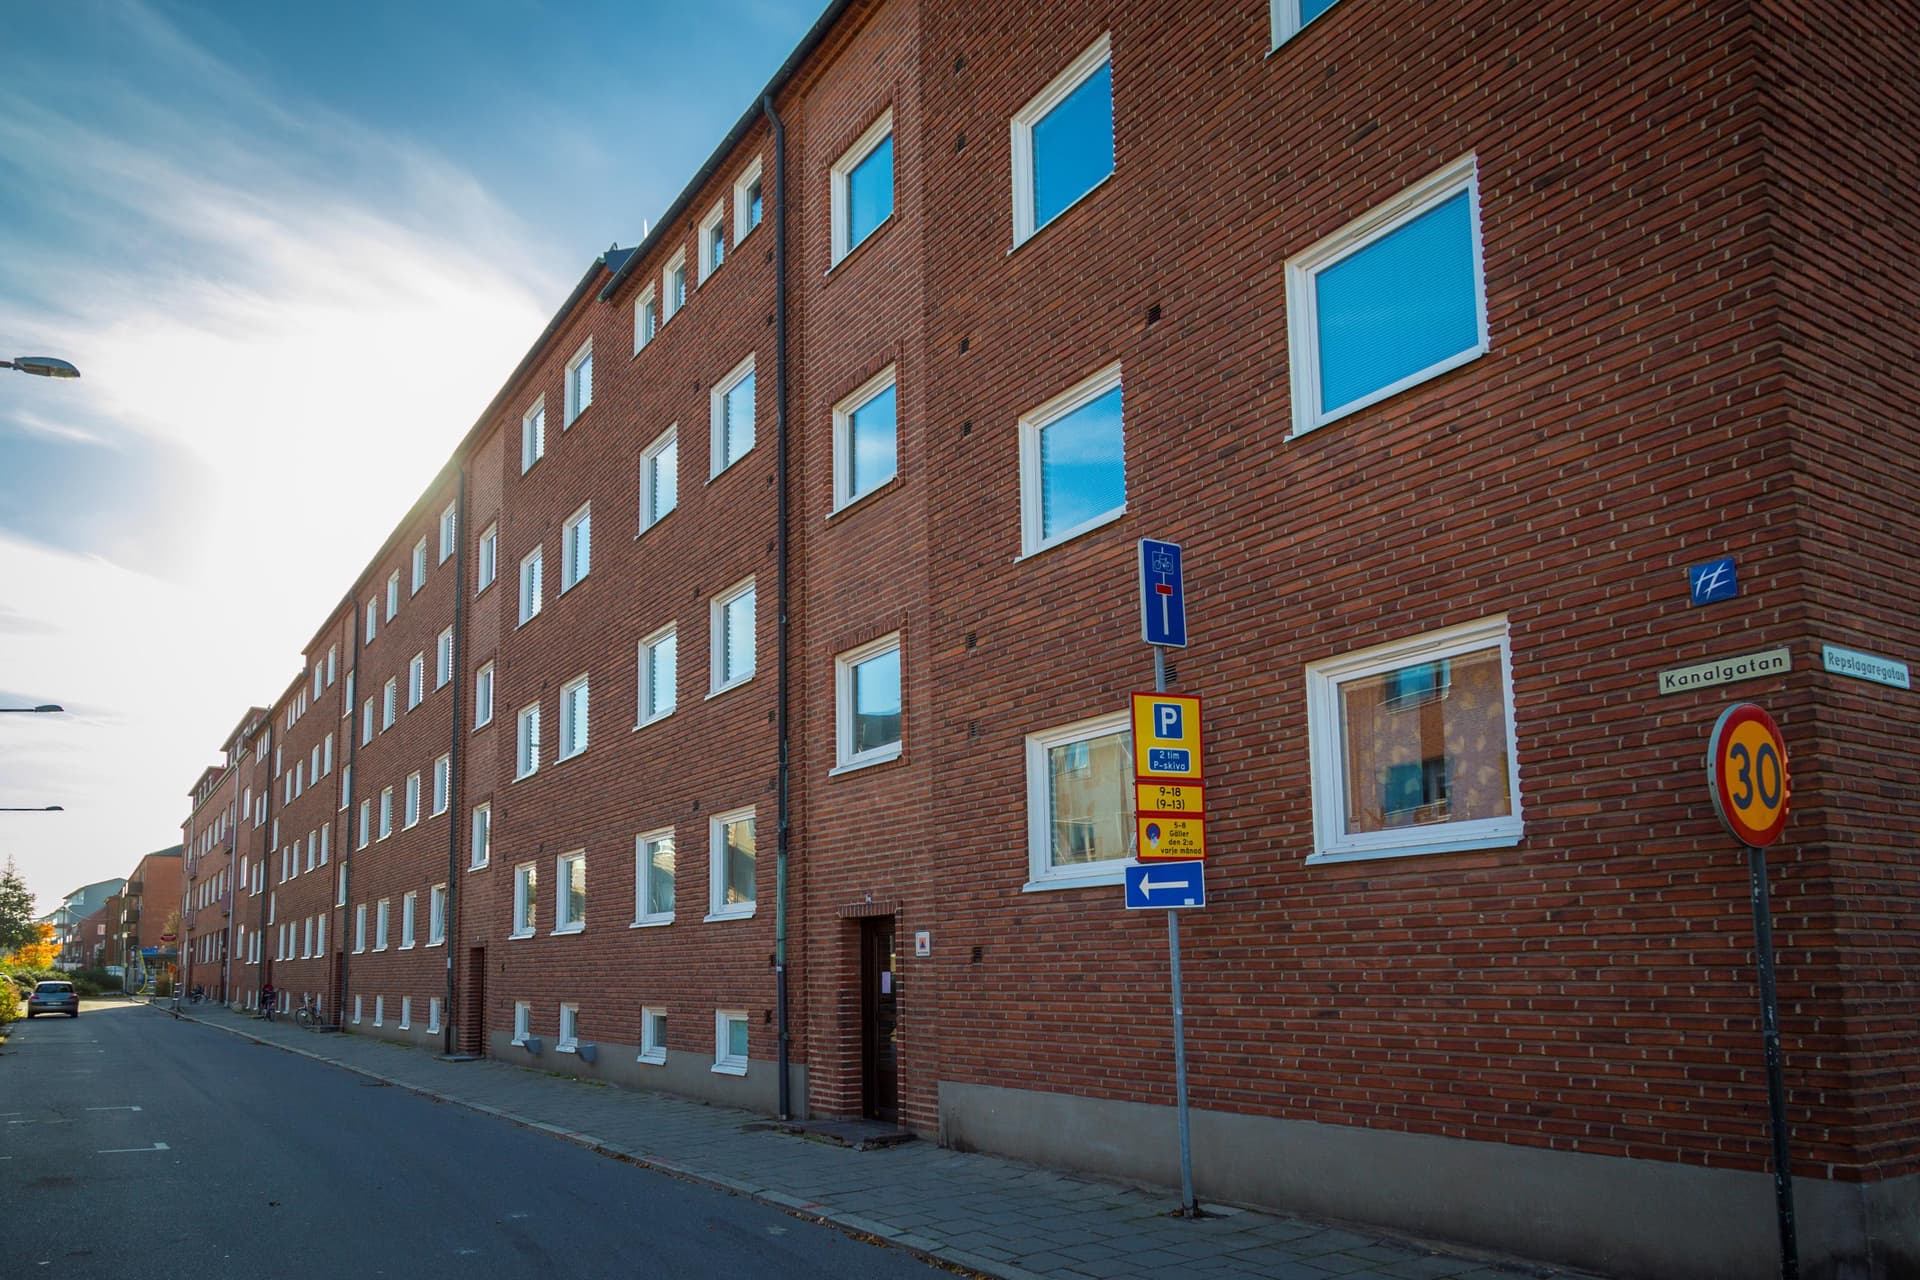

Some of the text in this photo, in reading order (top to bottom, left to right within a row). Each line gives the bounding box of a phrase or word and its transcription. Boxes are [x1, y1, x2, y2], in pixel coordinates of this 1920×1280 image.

[1665, 654, 1784, 688] Kanalgatan
[1827, 651, 1906, 683] Repslagaregatan
[1161, 707, 1177, 736] P
[1159, 750, 1180, 760] 2 tim
[1153, 760, 1186, 770] P-skiva
[1729, 742, 1781, 810] 30
[1159, 787, 1181, 797] 9-18
[1156, 798, 1185, 810] (9-13)
[1169, 830, 1189, 838] Gäller
[1168, 838, 1182, 846] den
[1160, 846, 1202, 855] varje månad
